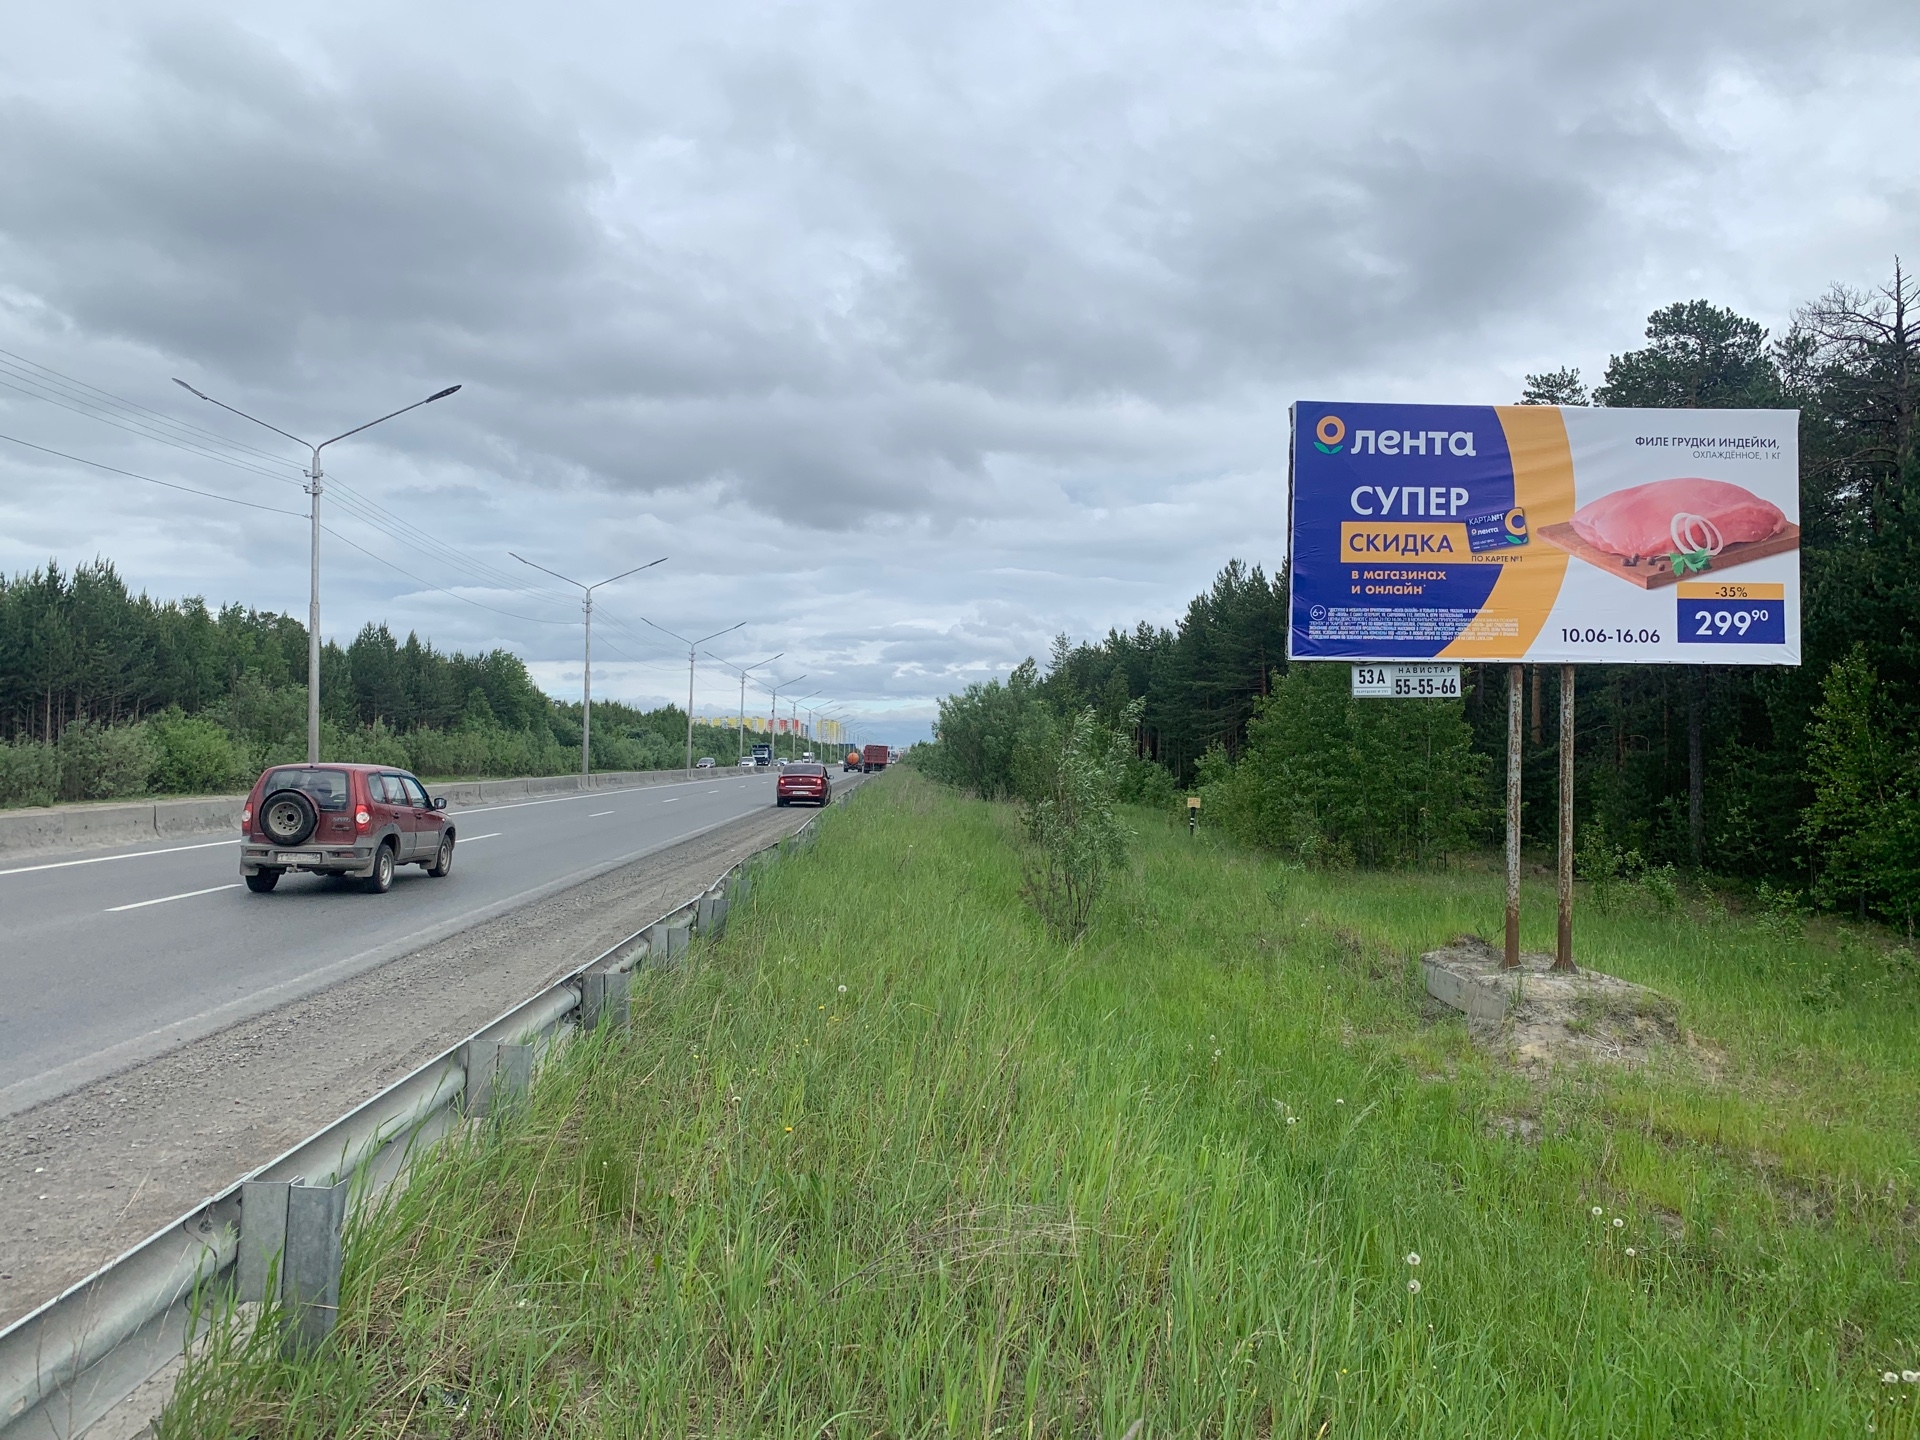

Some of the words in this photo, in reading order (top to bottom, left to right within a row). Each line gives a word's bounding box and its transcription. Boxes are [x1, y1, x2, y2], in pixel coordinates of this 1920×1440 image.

[1350, 429, 1477, 457] лента
[1635, 436, 1669, 447] ФИЛЕ
[1672, 437, 1716, 449] ГРУДКИ
[1719, 436, 1780, 450] ИНДЕЙКИ,
[1692, 450, 1762, 460] ОХЛАЖДЁННОЕ,
[1765, 452, 1769, 460] 1
[1771, 452, 1781, 460] КГ
[1350, 485, 1470, 516] СУПЕР
[1349, 533, 1454, 556] СКИДКА
[1471, 555, 1484, 563] ПО
[1485, 555, 1509, 563] КАРТЕ
[1351, 570, 1360, 580] в
[1363, 570, 1447, 580] магазинах
[1351, 585, 1361, 595] и
[1714, 586, 1748, 598] -35%
[1312, 608, 1324, 617] 6+
[1561, 628, 1661, 644] 10.06-16.06
[1358, 669, 1375, 684] 53
[1376, 669, 1386, 684] А
[1398, 666, 1453, 674] НАВИСТАР
[1395, 678, 1457, 695] 55-55-66
